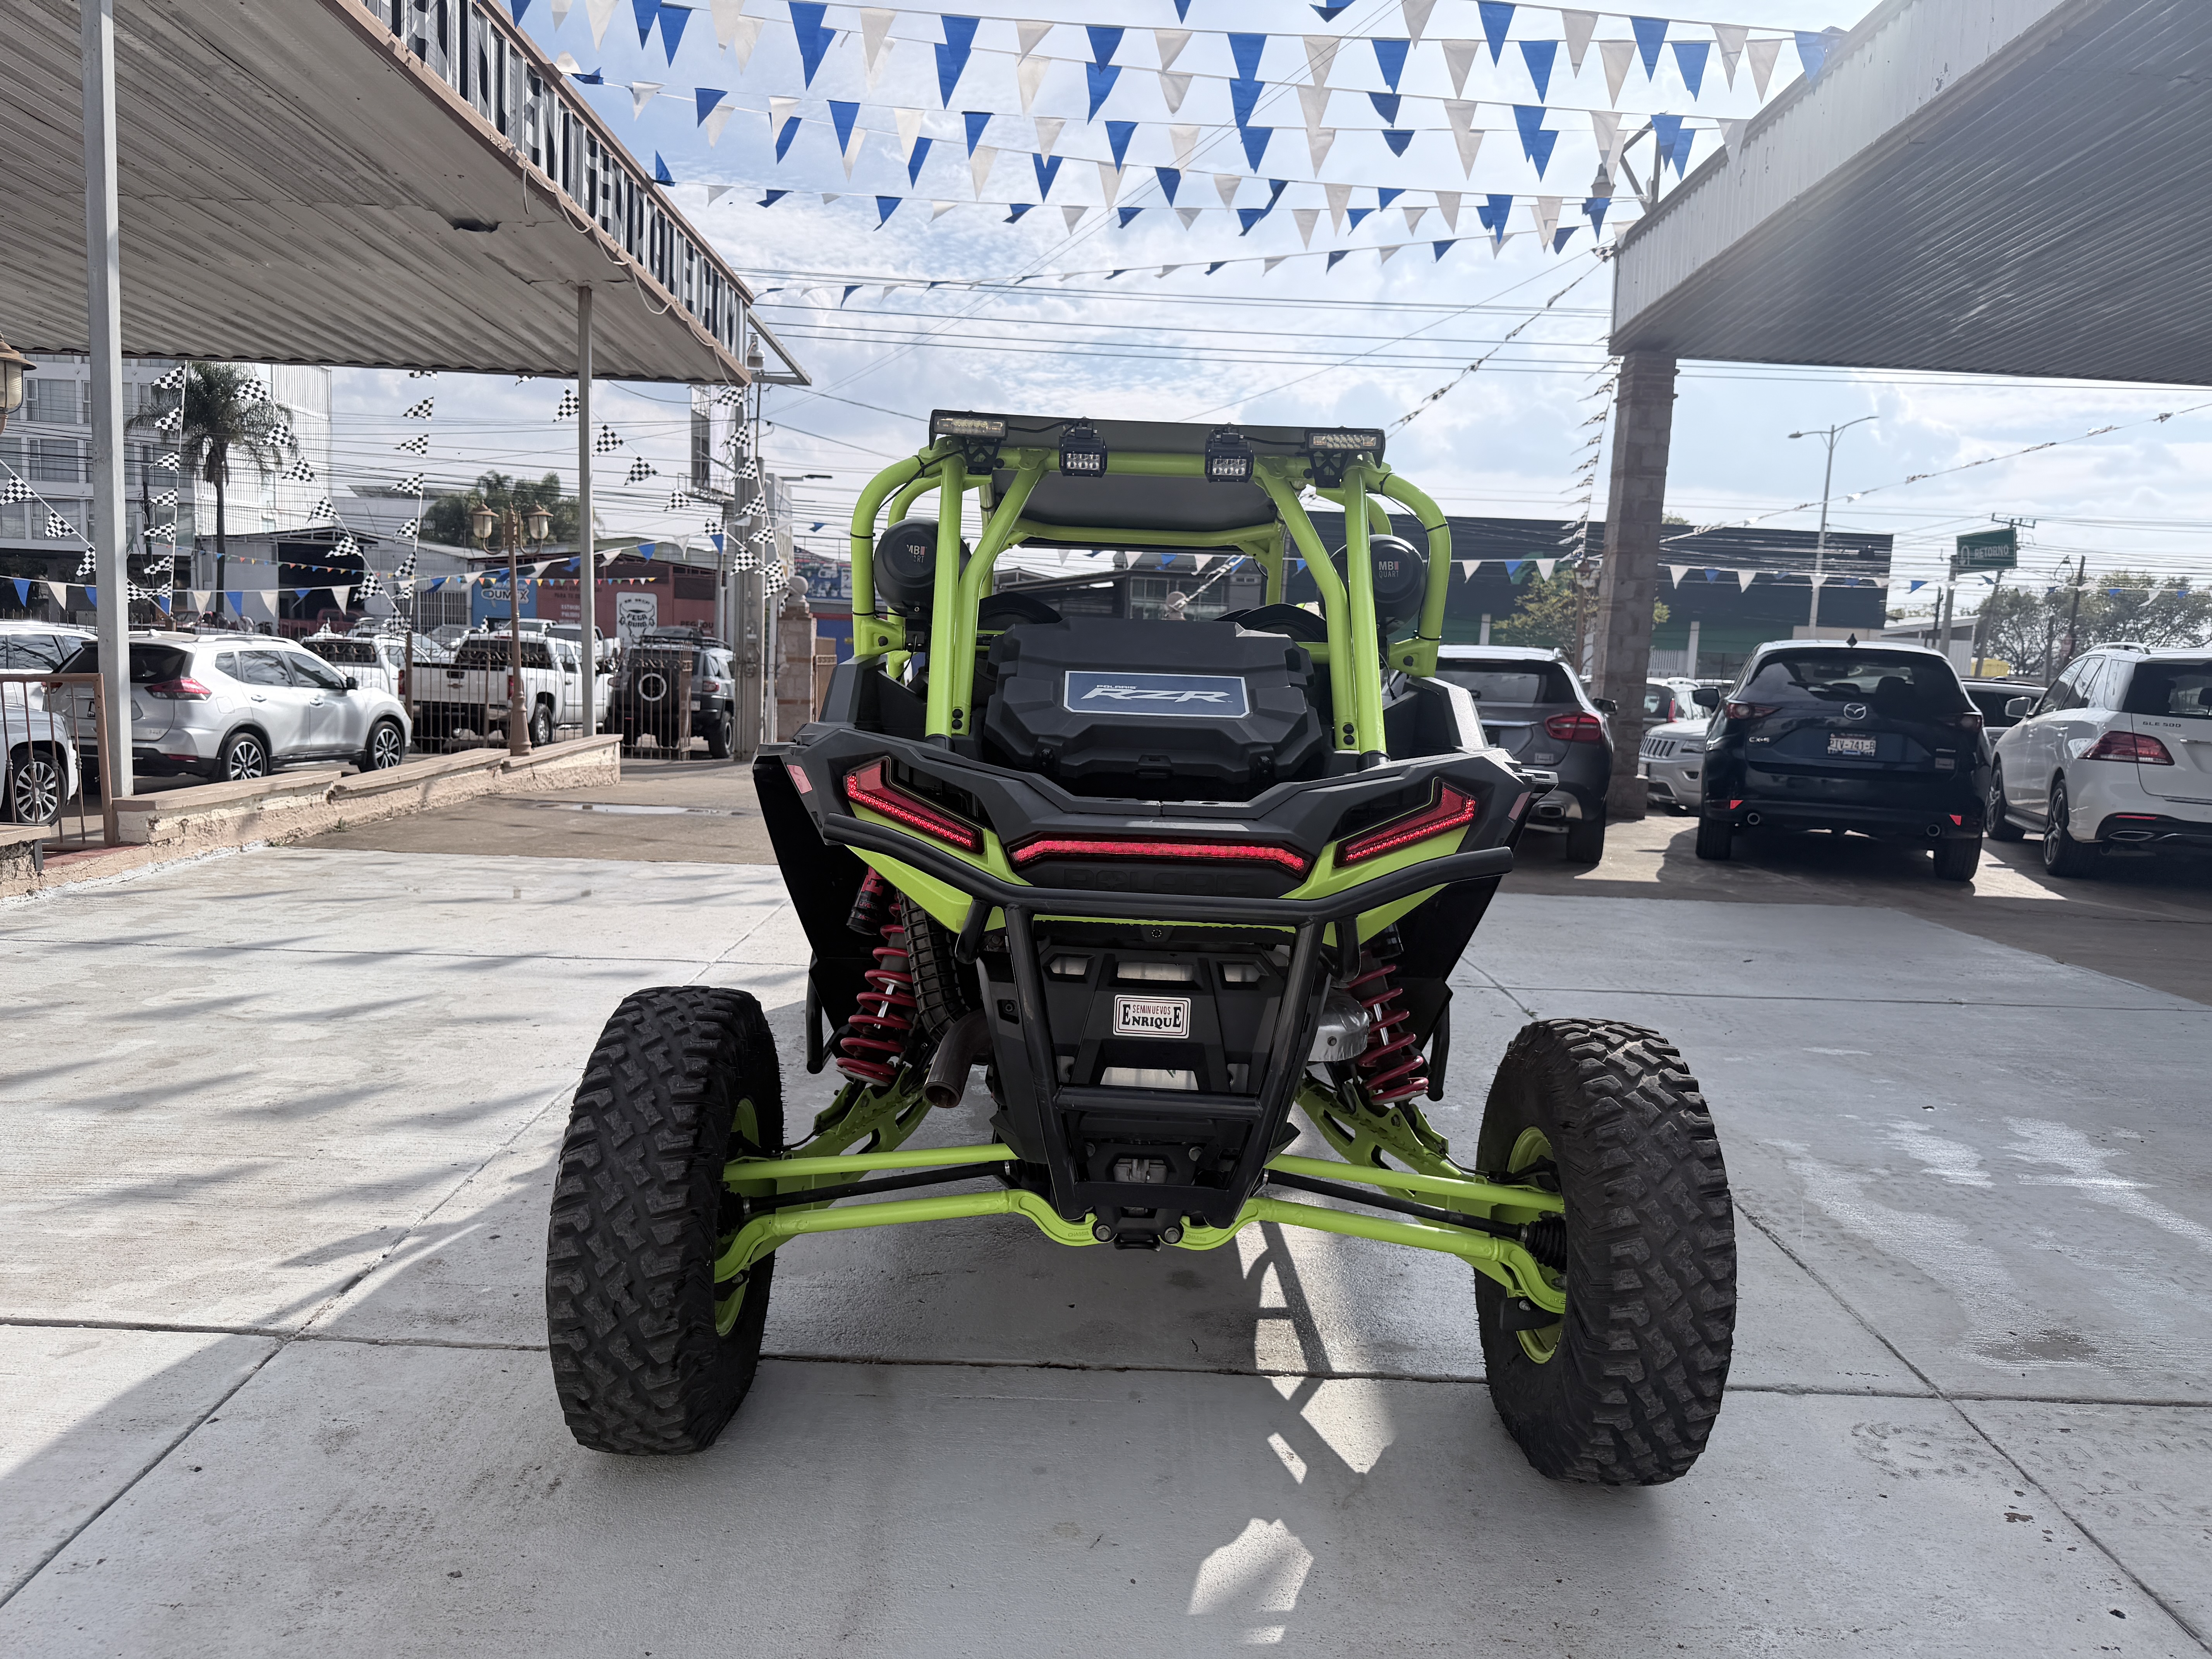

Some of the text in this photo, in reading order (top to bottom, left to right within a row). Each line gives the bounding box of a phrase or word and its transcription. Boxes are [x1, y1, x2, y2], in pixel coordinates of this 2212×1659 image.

[1975, 544, 2009, 559] RETORNO
[1379, 570, 1399, 579] QUART
[1081, 688, 1230, 702] RZR
[1121, 1004, 1181, 1029] ENRIQUE
[1132, 1004, 1171, 1015] SEMINUEVOS
